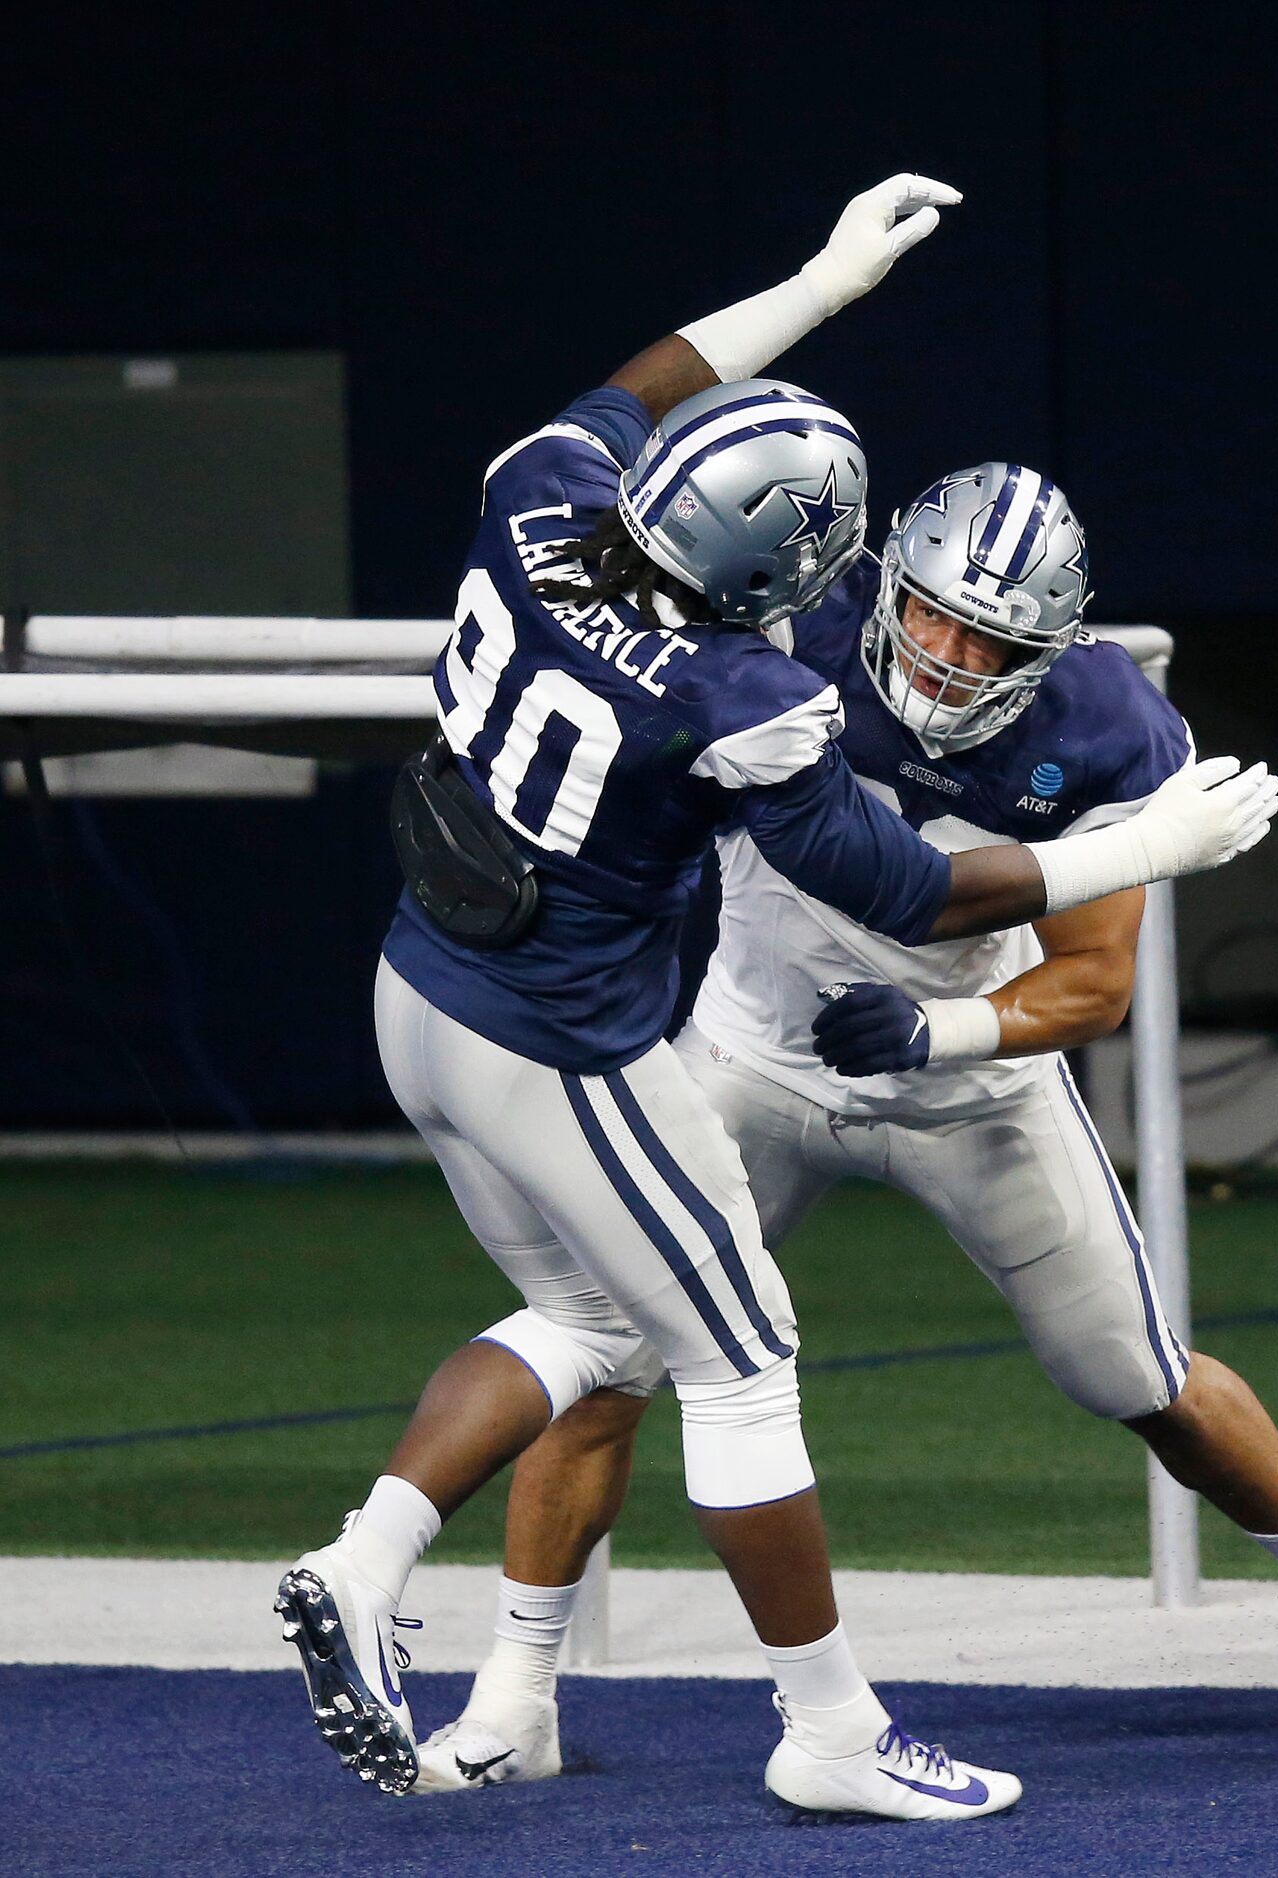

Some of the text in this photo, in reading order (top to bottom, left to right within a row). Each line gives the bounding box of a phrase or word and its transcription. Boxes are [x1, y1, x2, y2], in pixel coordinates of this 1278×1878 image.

[619, 494, 650, 549] OWBOYS
[960, 591, 999, 613] COWBOYS
[436, 568, 624, 858] 90
[899, 760, 965, 797] COWBOYS
[1016, 794, 1059, 815] AT&T
